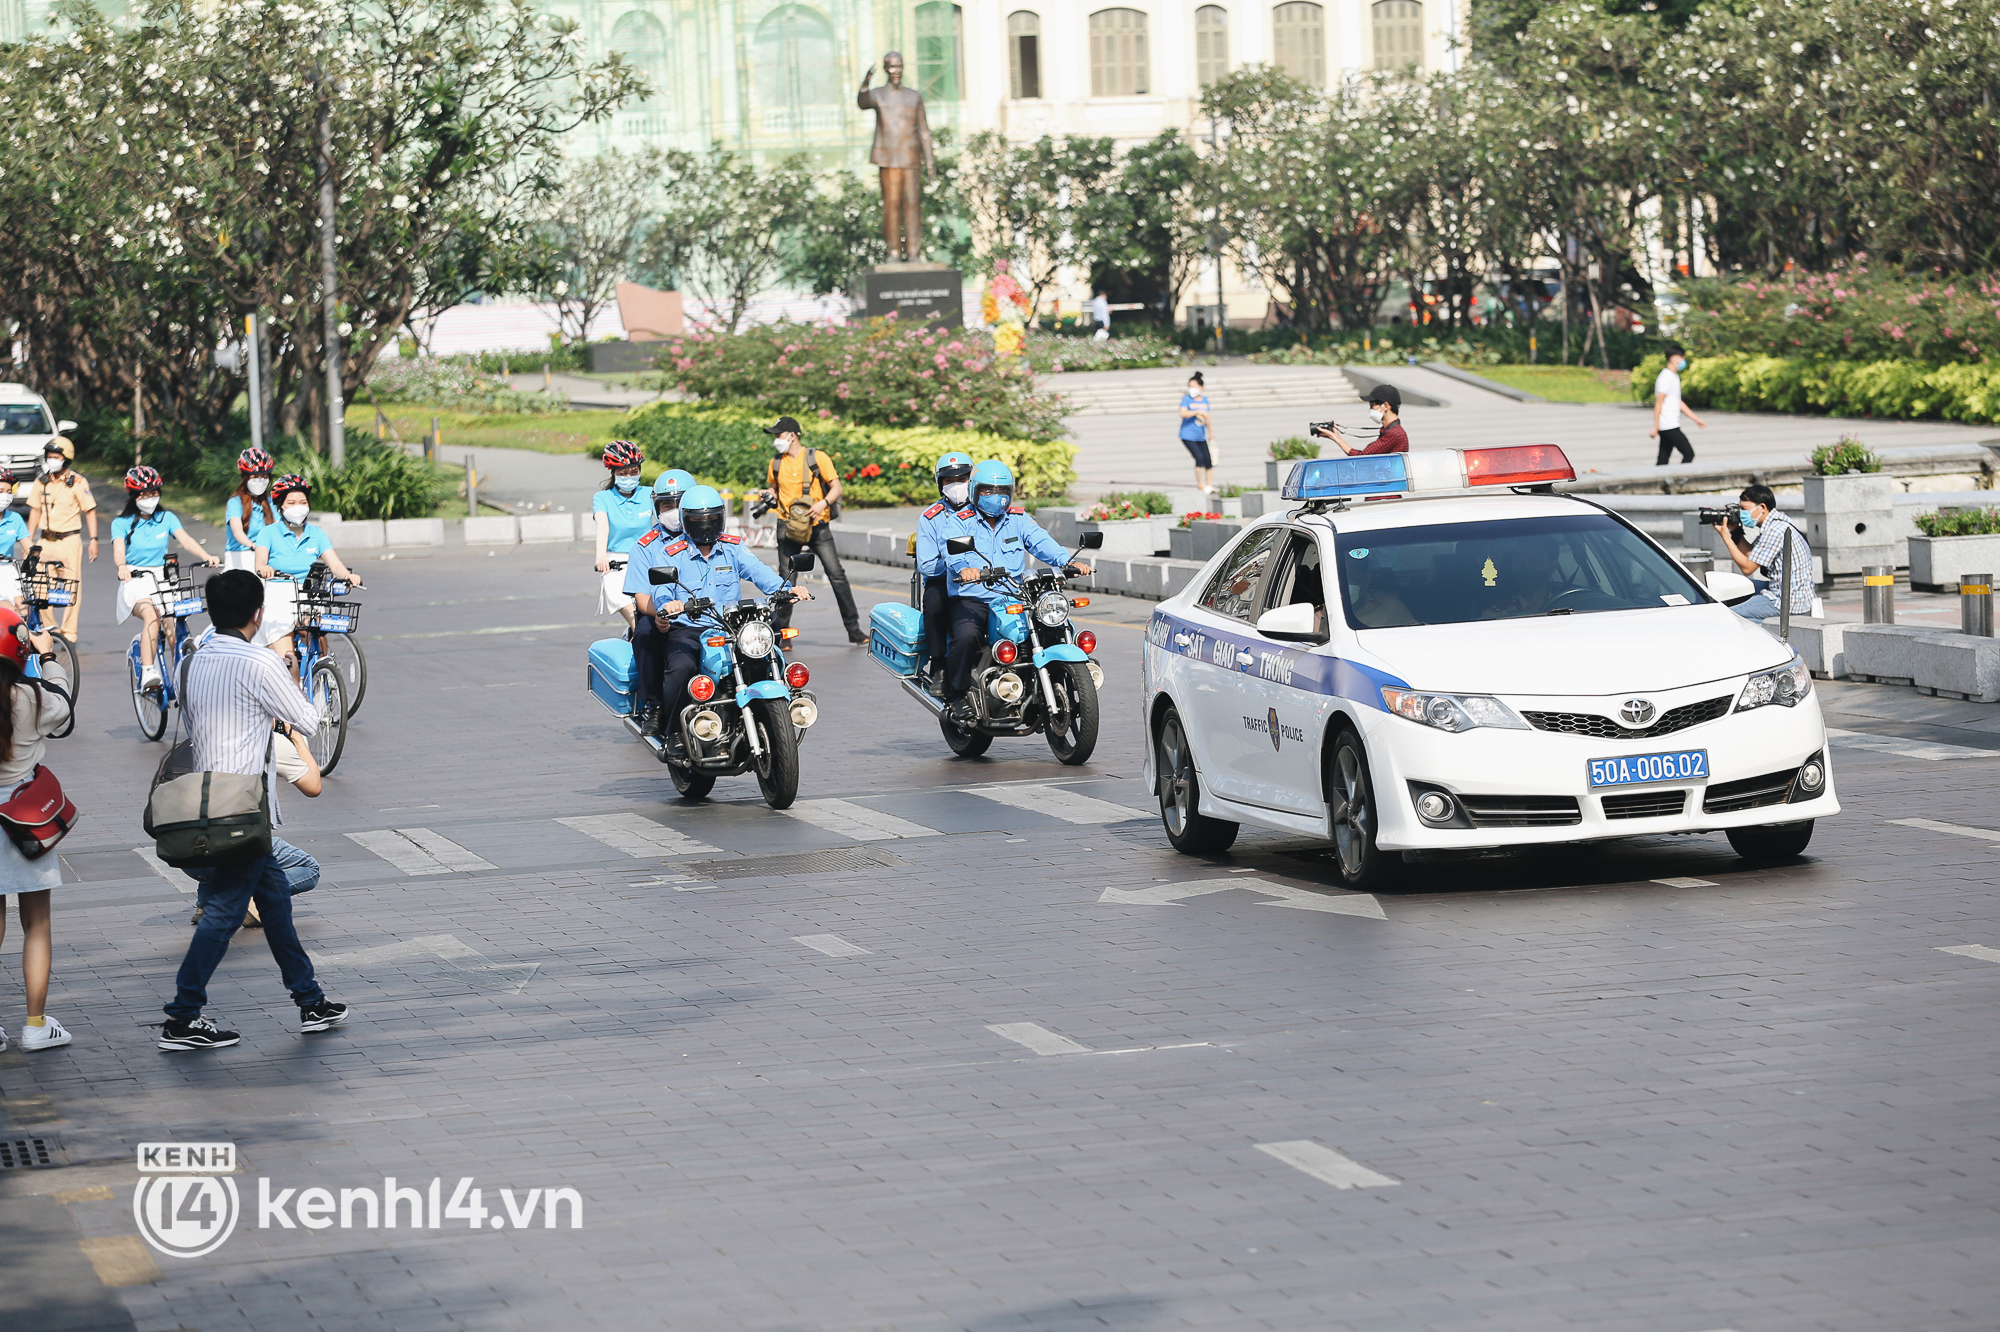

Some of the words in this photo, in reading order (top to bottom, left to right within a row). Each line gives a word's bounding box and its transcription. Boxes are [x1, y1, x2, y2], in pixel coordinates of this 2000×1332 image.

[874, 639, 897, 661] TTGT
[1152, 614, 1171, 648] CẢNH
[1187, 628, 1206, 660] SÁT
[1213, 639, 1235, 669] GIAO
[1260, 650, 1294, 685] THÔNG
[1243, 716, 1268, 733] TRAFFIC
[1281, 724, 1303, 742] POLICE
[1591, 753, 1705, 784] 50A-006.02
